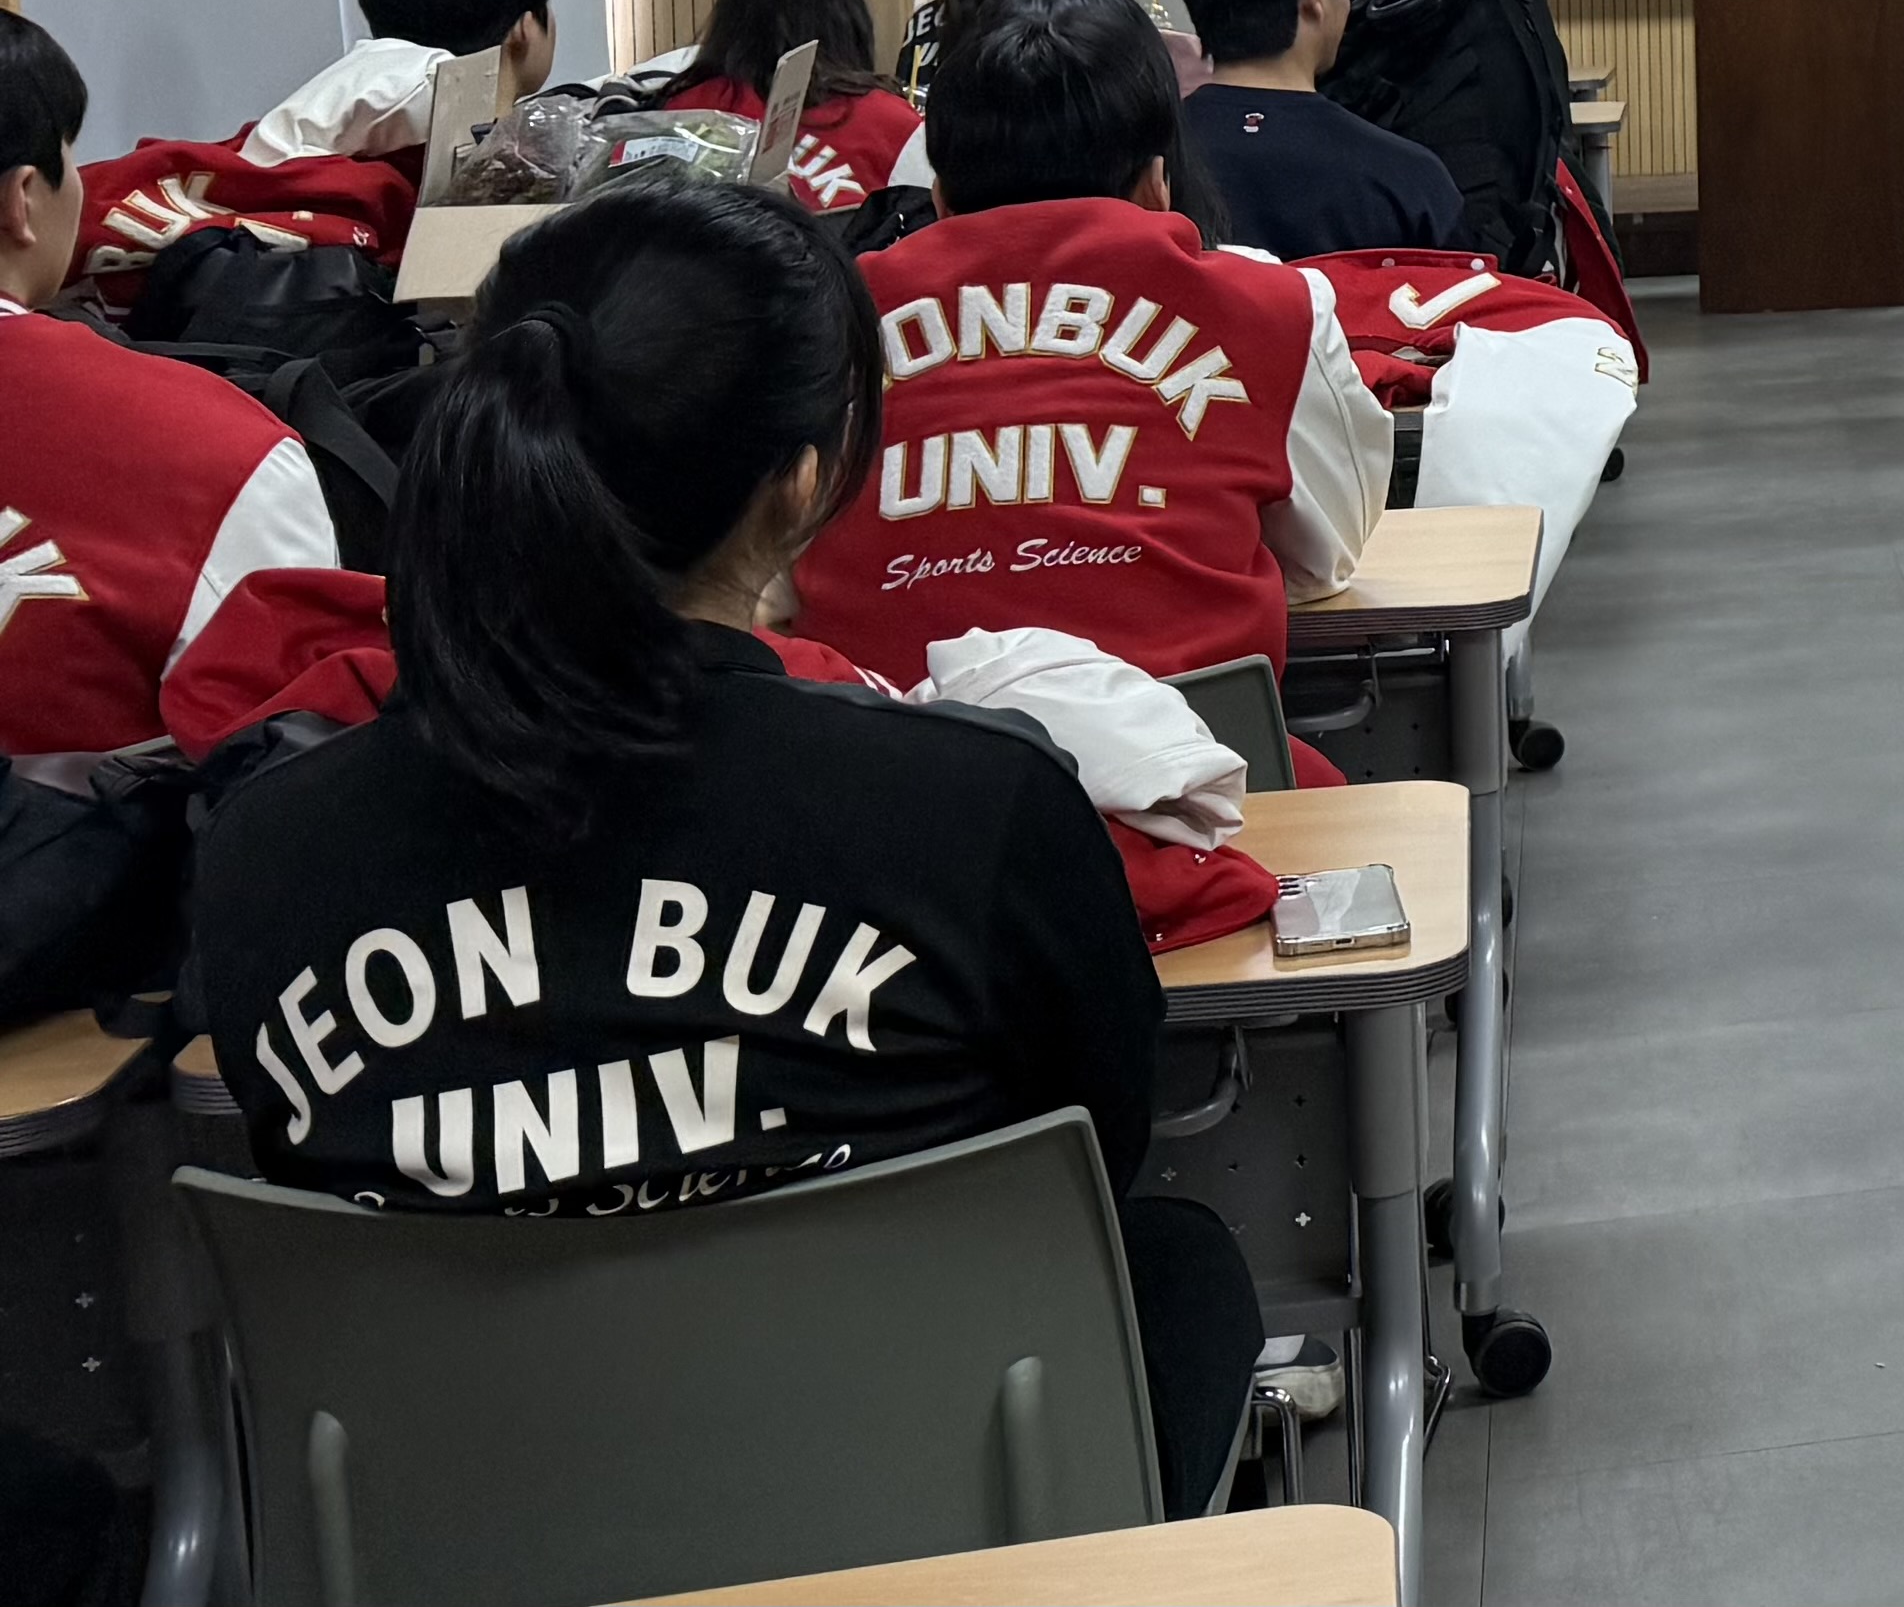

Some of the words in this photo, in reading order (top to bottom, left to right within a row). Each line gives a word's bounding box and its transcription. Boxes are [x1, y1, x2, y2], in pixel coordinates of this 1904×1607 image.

[878, 423, 1167, 521] UNIV.
[881, 547, 995, 591] Sports
[1009, 538, 1142, 572] Science
[256, 885, 541, 1146] JEON
[624, 878, 918, 1054] BUK
[391, 1034, 788, 1196] UNIV.
